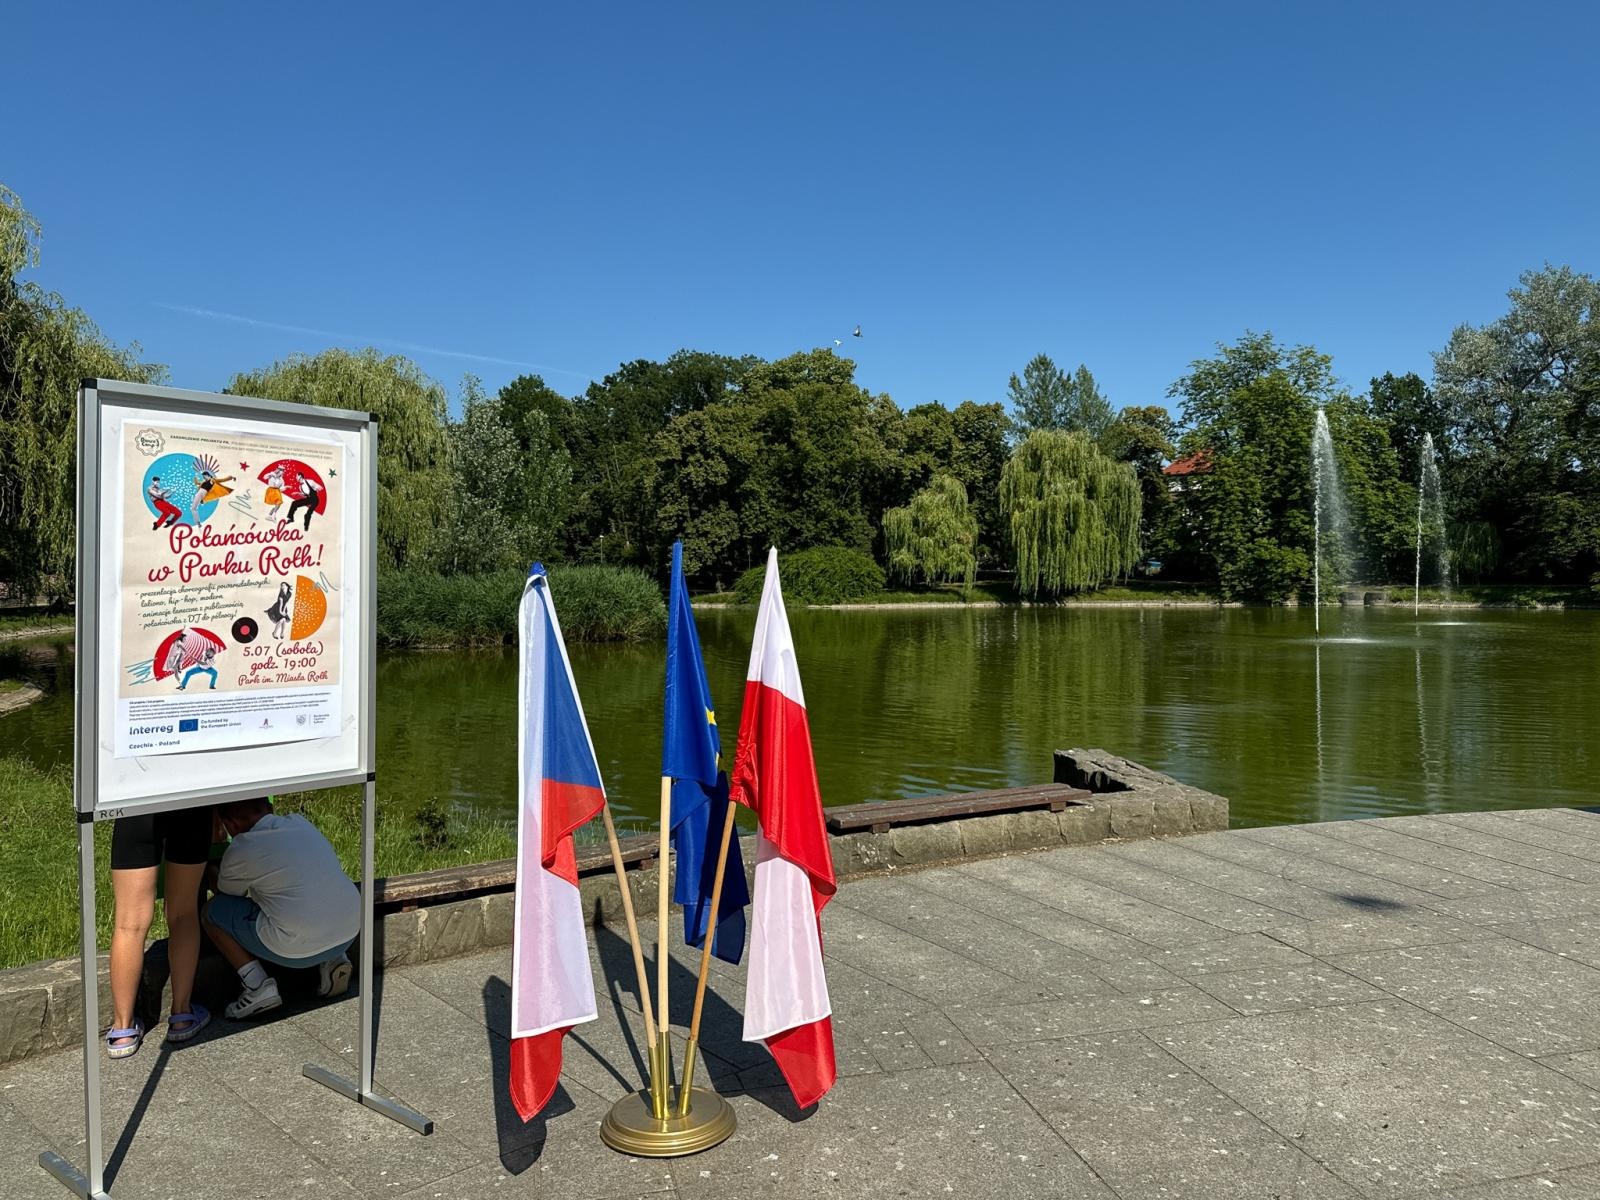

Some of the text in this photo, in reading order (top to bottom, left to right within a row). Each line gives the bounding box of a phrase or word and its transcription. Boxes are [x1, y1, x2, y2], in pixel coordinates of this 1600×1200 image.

[169, 519, 304, 554] Potańcówka
[148, 544, 324, 583] w Parku Roth!
[140, 588, 177, 598] prezentacja
[178, 582, 215, 595] choreografii
[200, 592, 224, 601] modern
[172, 606, 199, 615] taneczne
[188, 613, 202, 624] DJ
[201, 612, 210, 621] do
[243, 640, 324, 657] 5.07 (sobota)
[249, 656, 316, 676] godz. 19:00
[238, 670, 328, 686] Park im. Miasta Roth
[129, 725, 174, 736] Interreg
[128, 741, 154, 749] Czechia
[98, 808, 124, 819] RCK
